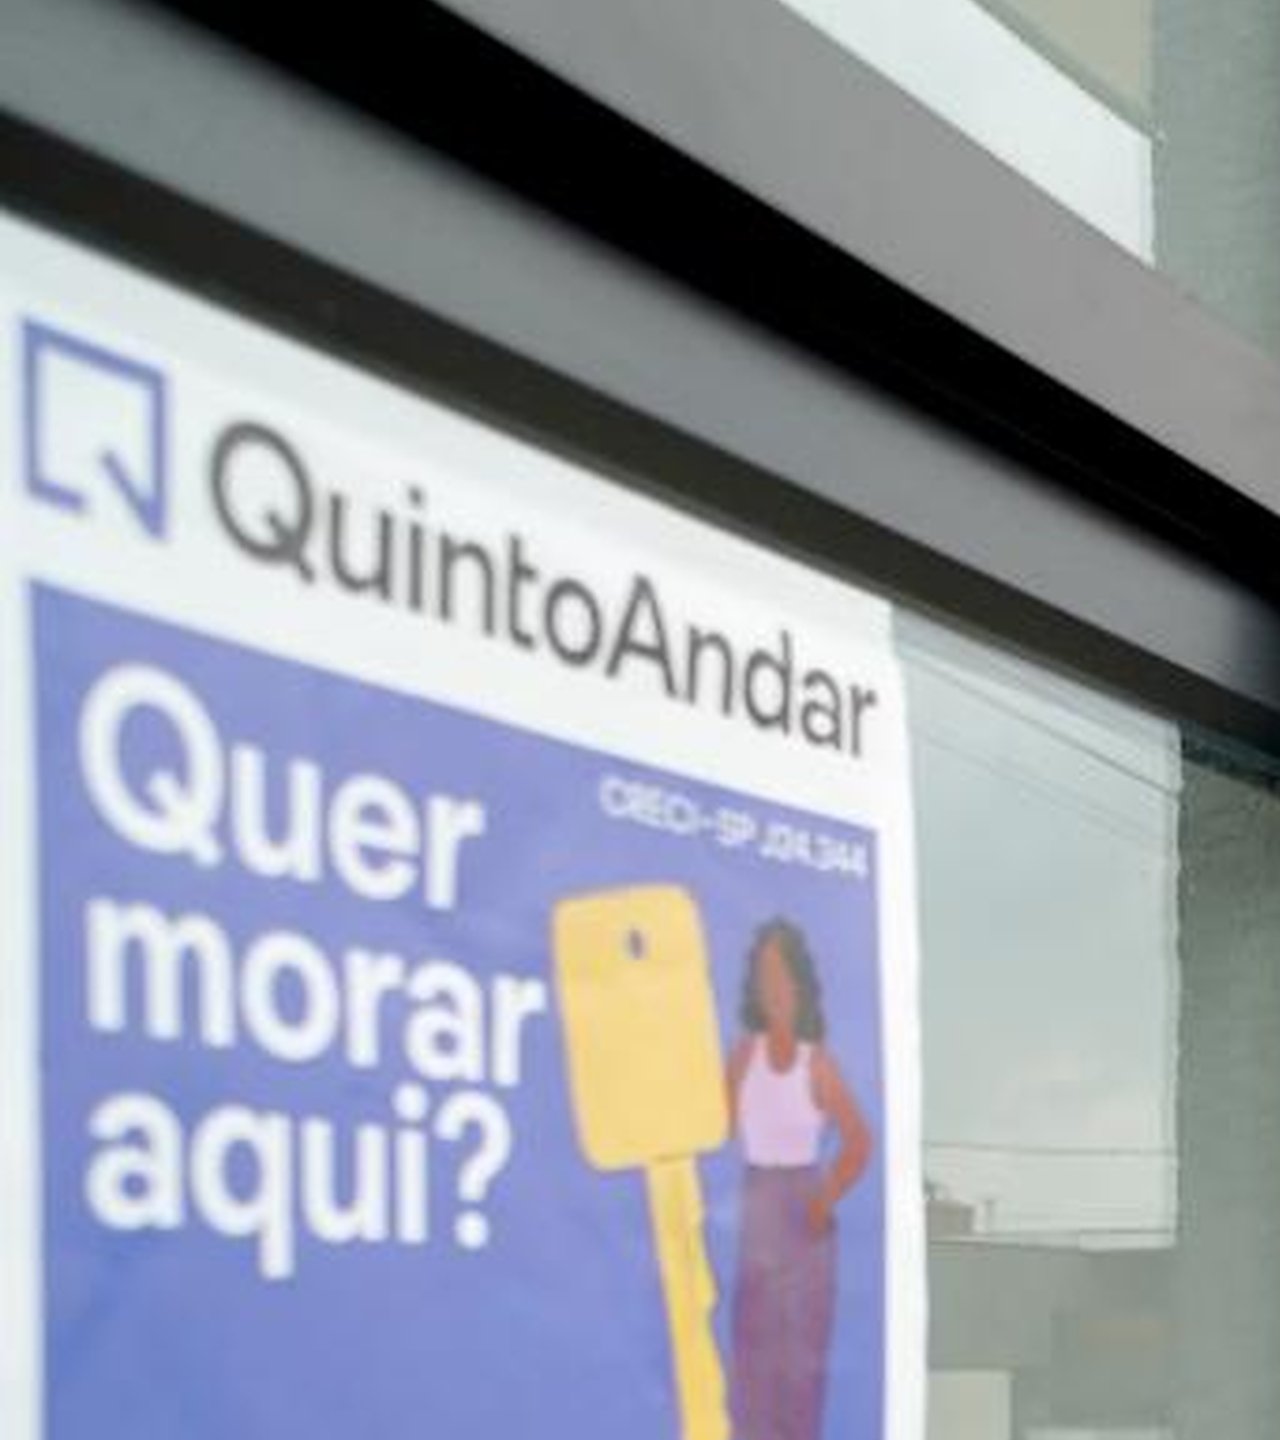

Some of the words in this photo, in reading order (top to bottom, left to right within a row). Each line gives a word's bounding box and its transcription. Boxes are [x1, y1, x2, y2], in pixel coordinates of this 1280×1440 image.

[210, 421, 878, 758] QuintoAndar
[78, 663, 485, 910] Quer
[85, 896, 547, 1088] morar
[84, 1083, 513, 1281] aqui?
